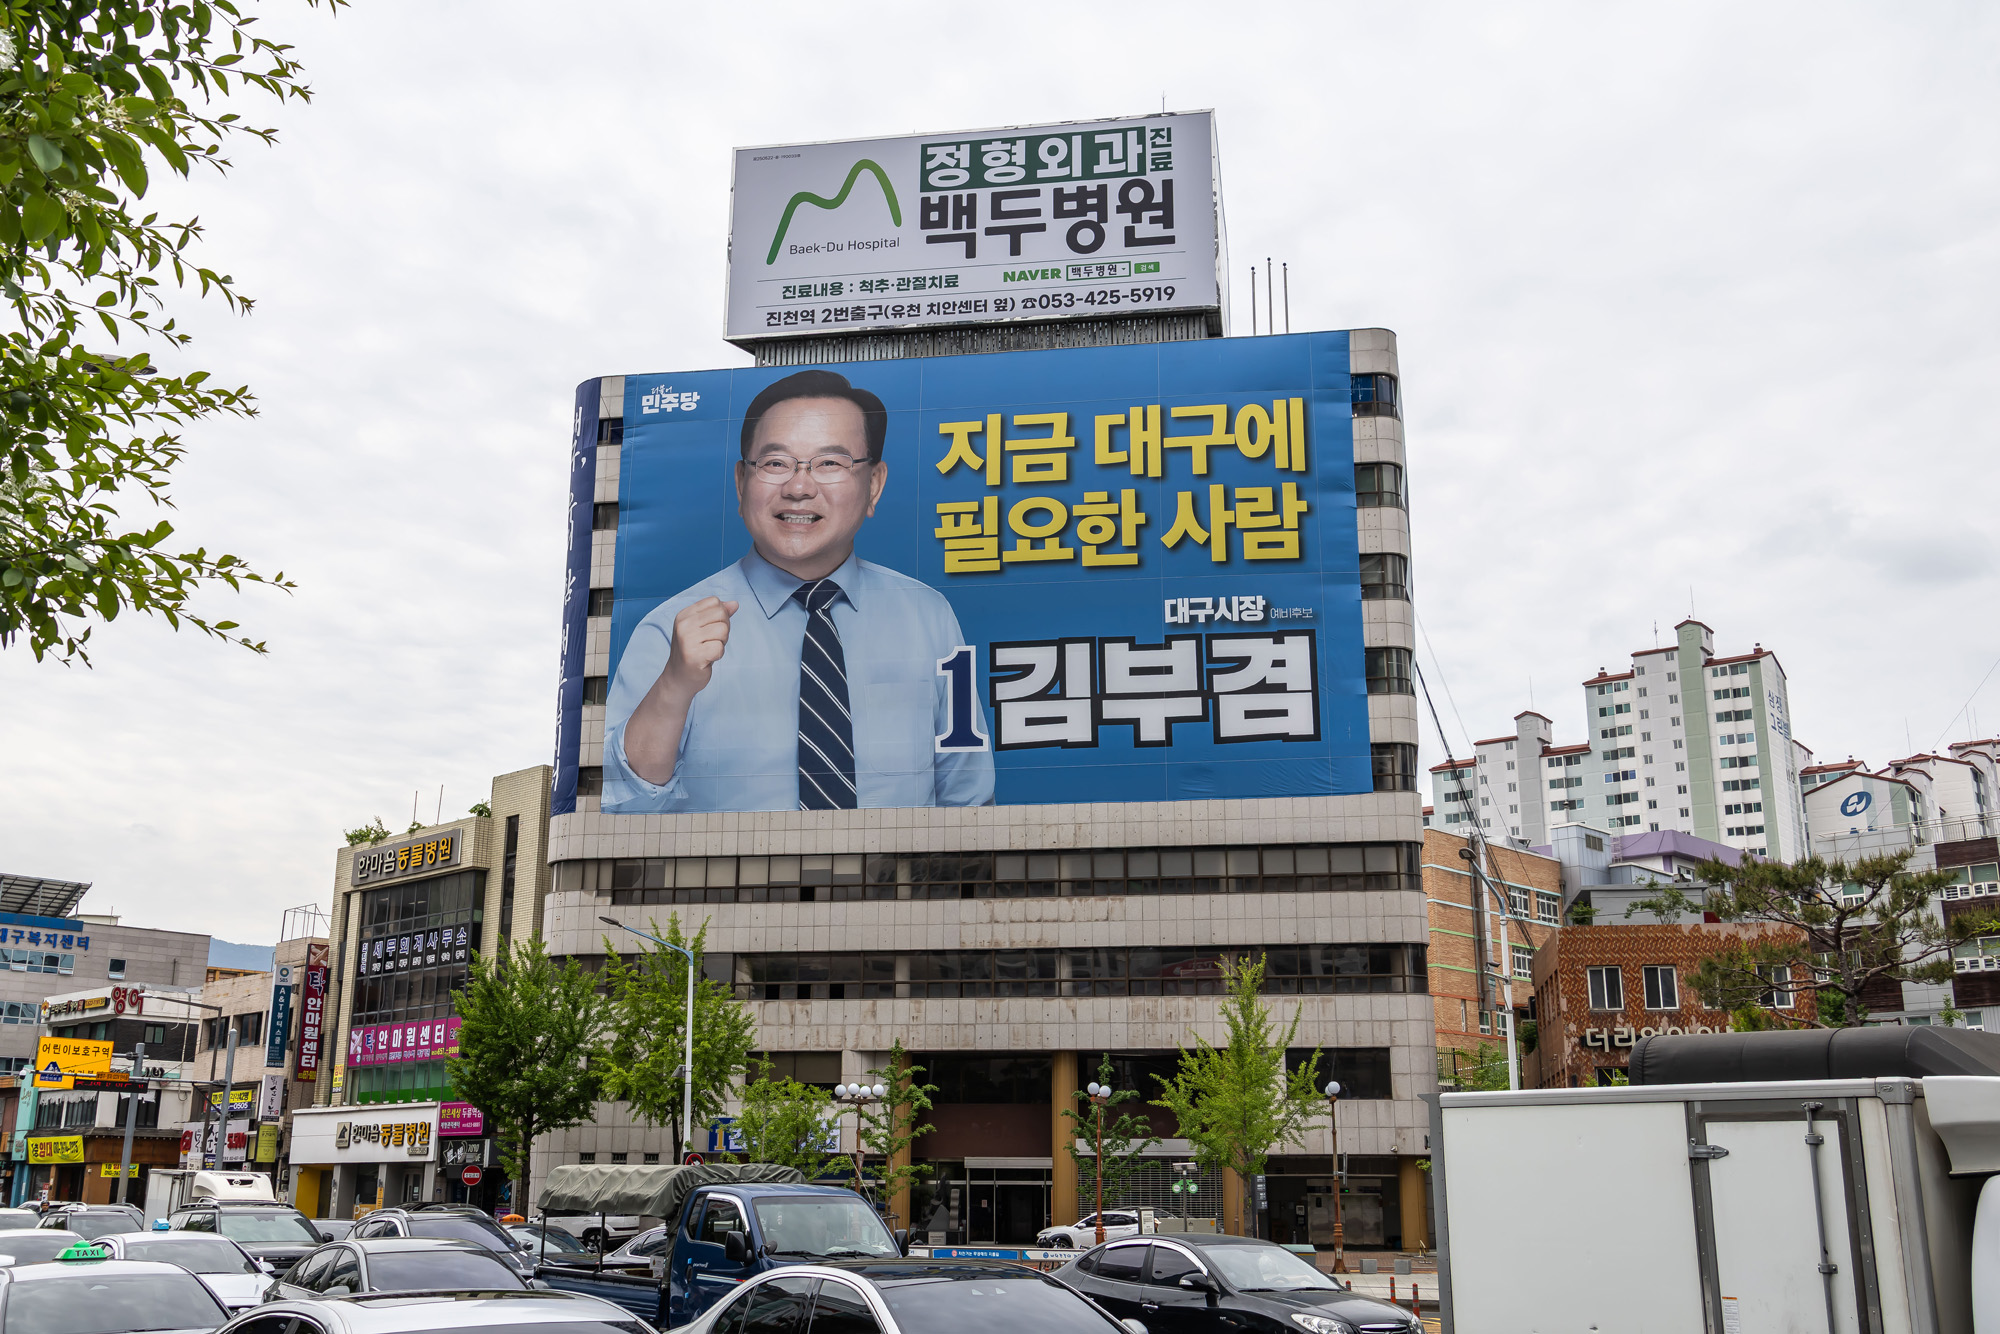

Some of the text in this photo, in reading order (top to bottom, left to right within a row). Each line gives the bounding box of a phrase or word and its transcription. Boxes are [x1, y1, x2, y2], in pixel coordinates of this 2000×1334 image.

[926, 127, 1174, 188] 정형외과 진료
[920, 178, 1176, 259] 백두병원
[789, 236, 900, 255] Baek-Du Hospital
[782, 281, 844, 300] 진료내용
[859, 274, 960, 294] 척추·관절치료
[1003, 263, 1155, 283] NAVER 백두병원 검색
[766, 308, 815, 327] 진천역
[821, 302, 921, 324] 2번출구(유천
[926, 298, 988, 316] 치안센터
[993, 297, 1016, 313] 옆)
[641, 391, 701, 415] 민주당
[650, 384, 673, 395] 더불어
[935, 397, 1306, 486] 지금 대구에
[934, 482, 1308, 574] 필요한 사람
[1164, 594, 1314, 624] 대구시장 예비후보
[935, 631, 1319, 753] 1 김부겸
[373, 926, 467, 959] 세무회계사무소
[42, 1043, 110, 1058] 어린이보호구역
[74, 1249, 100, 1257] TAXI
